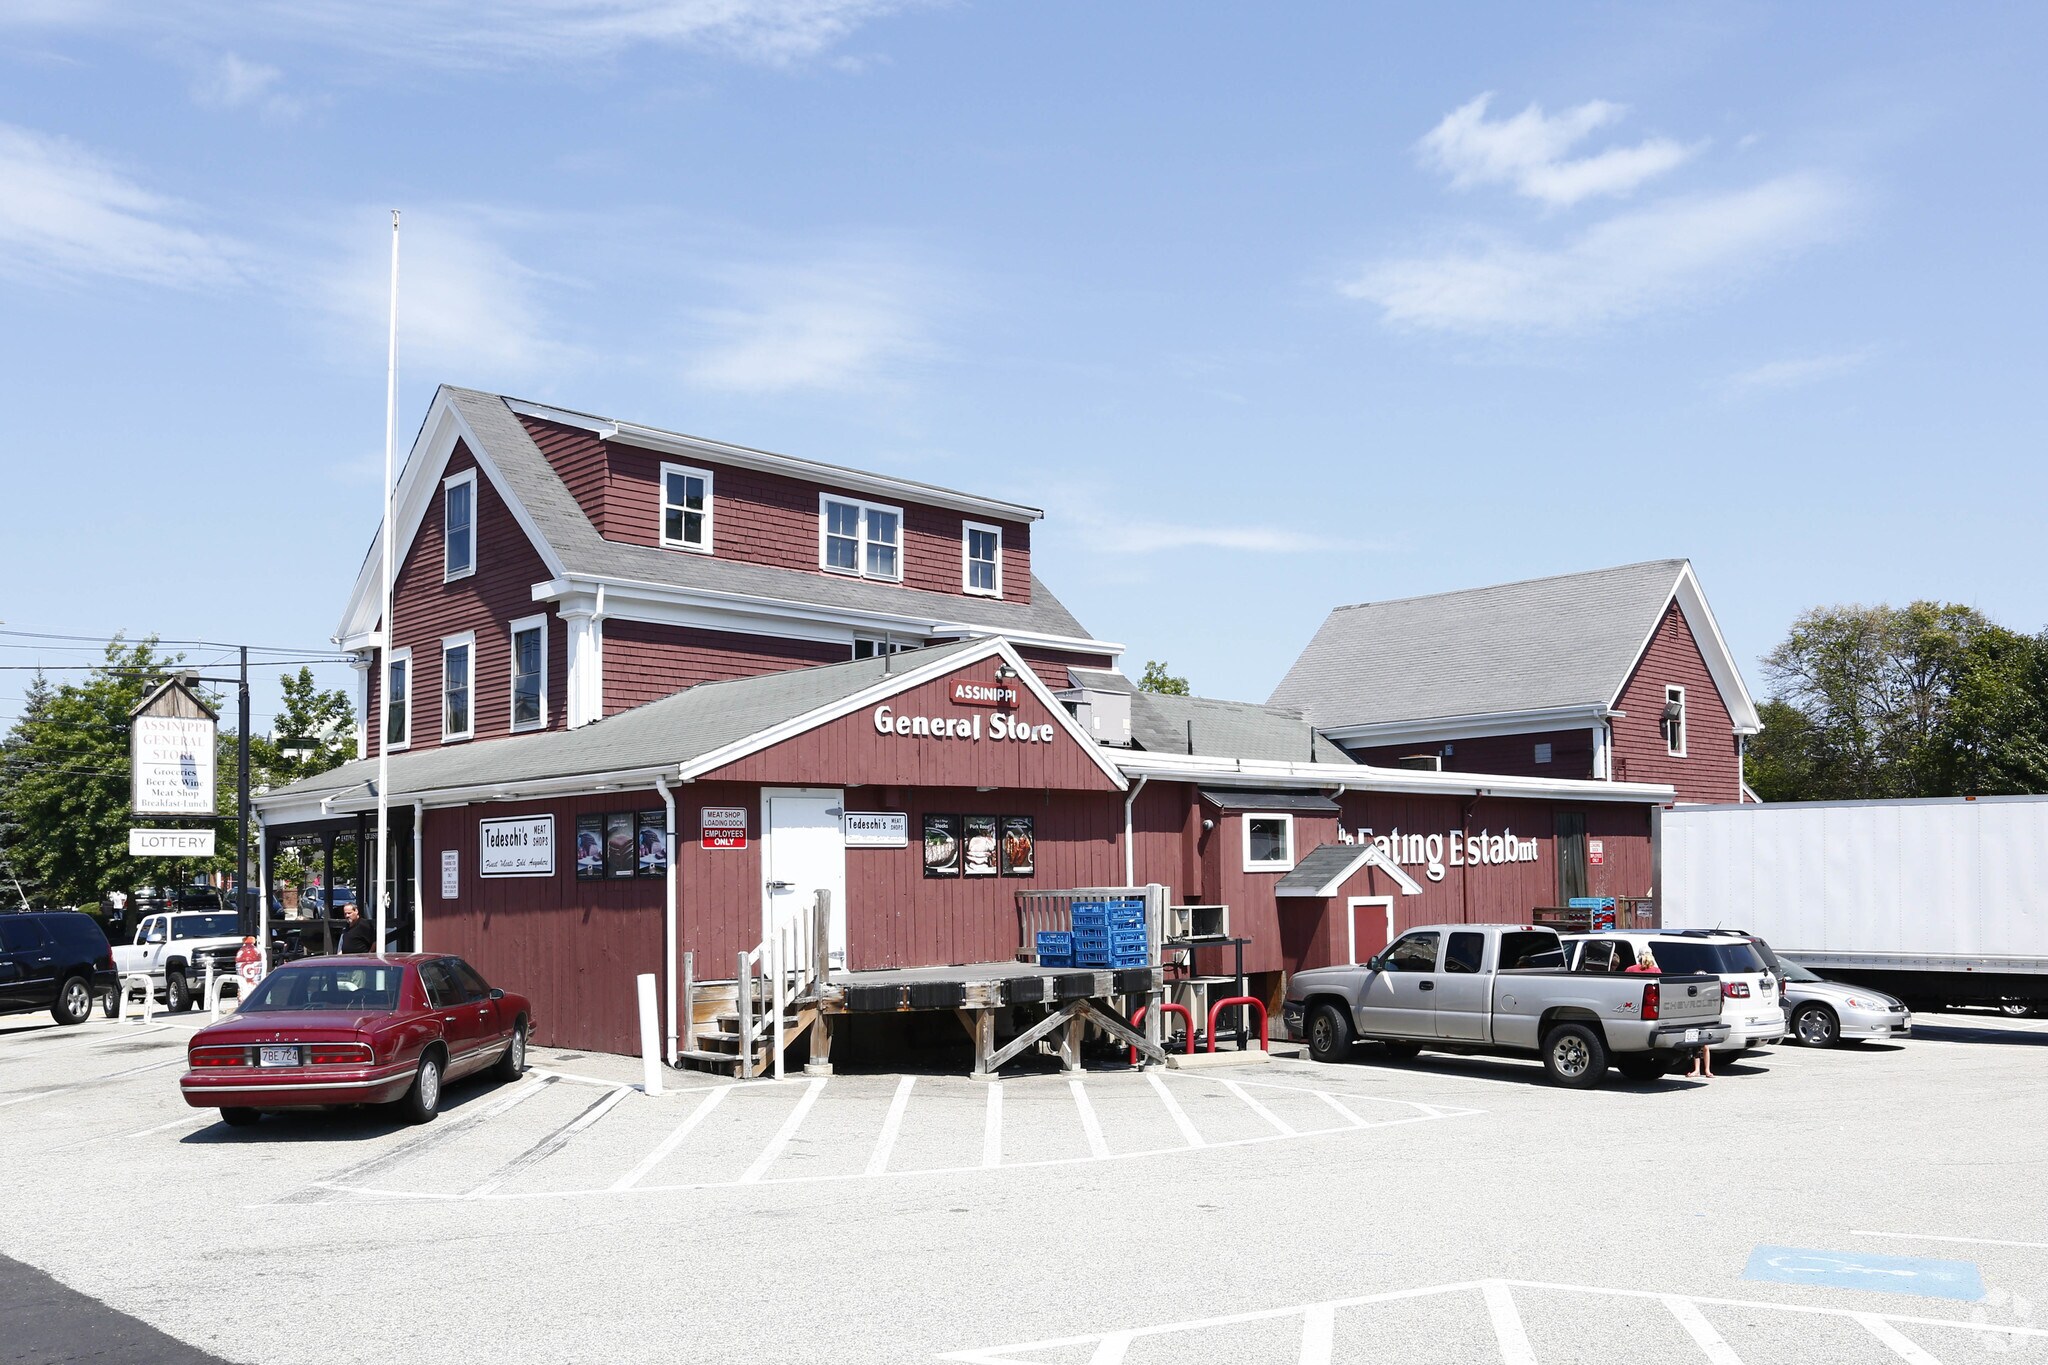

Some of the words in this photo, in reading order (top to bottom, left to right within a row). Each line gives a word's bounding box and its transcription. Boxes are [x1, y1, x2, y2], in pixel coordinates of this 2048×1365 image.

[955, 684, 1016, 703] ASSINIPPI
[141, 720, 207, 733] ASSINIPPI
[873, 705, 981, 741] General
[989, 712, 1054, 742] Store
[143, 735, 205, 747] GENERAL
[152, 749, 196, 761] STORE
[153, 767, 197, 777] Groceries
[146, 778, 165, 787] Beer
[169, 779, 178, 787] &
[181, 778, 204, 788] Wine
[151, 788, 174, 797] Meat
[176, 788, 199, 799] Shop
[141, 799, 208, 809] Breakfast-Lunch
[704, 819, 728, 827] LOADING
[728, 819, 744, 827] DOCK
[848, 817, 887, 830] Tedeschi's
[533, 825, 546, 835] MEAT
[704, 829, 744, 838] EMPLOYEES
[141, 836, 206, 848] LOTTERY
[485, 826, 528, 848] Tedeschi's
[532, 837, 549, 847] SHOPS
[714, 837, 735, 846] ONLY
[1449, 827, 1539, 866] Estabmt
[242, 963, 256, 979] G
[1663, 999, 1719, 1010] CHEVROLET
[262, 1050, 279, 1061] 7BE
[281, 1050, 297, 1061] 724
